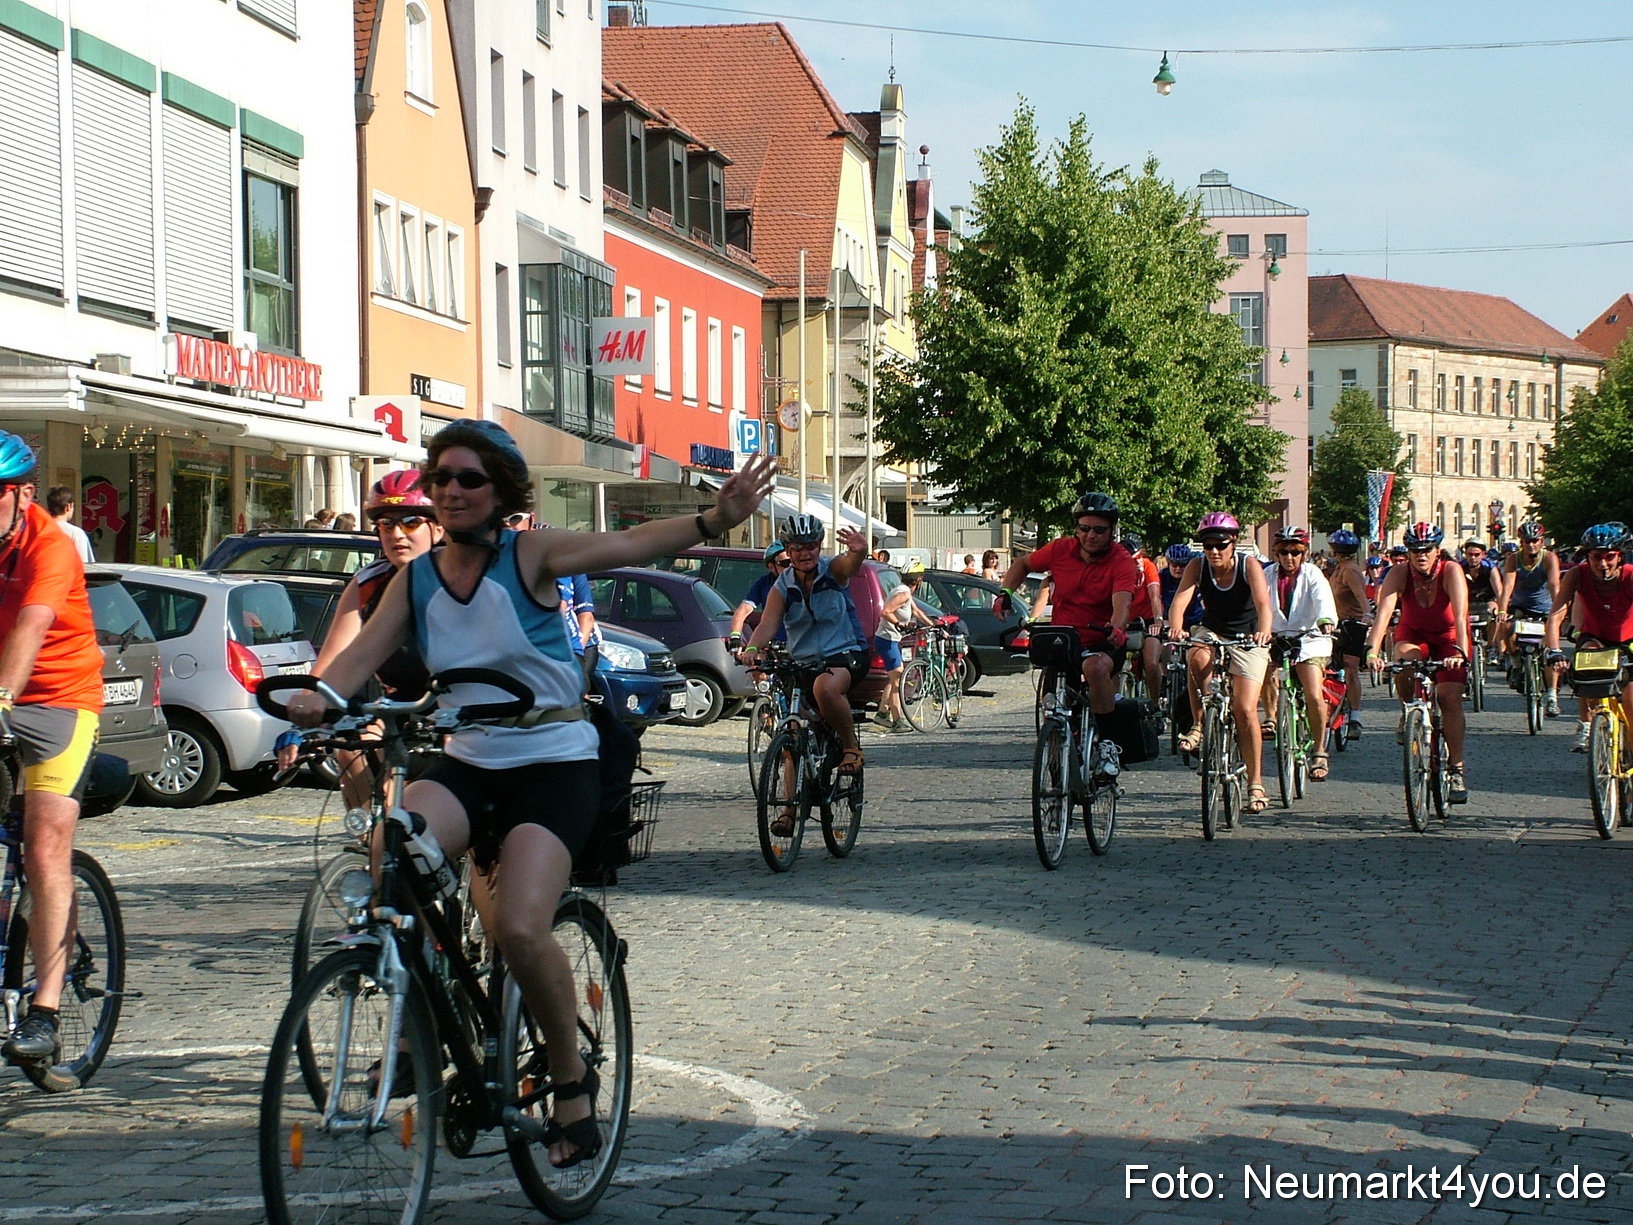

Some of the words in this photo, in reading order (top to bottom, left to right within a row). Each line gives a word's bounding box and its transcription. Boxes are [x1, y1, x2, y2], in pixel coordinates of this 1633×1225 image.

[599, 329, 647, 363] H&M
[175, 332, 323, 402] MARIEN-APOTHEKE
[744, 423, 756, 450] P
